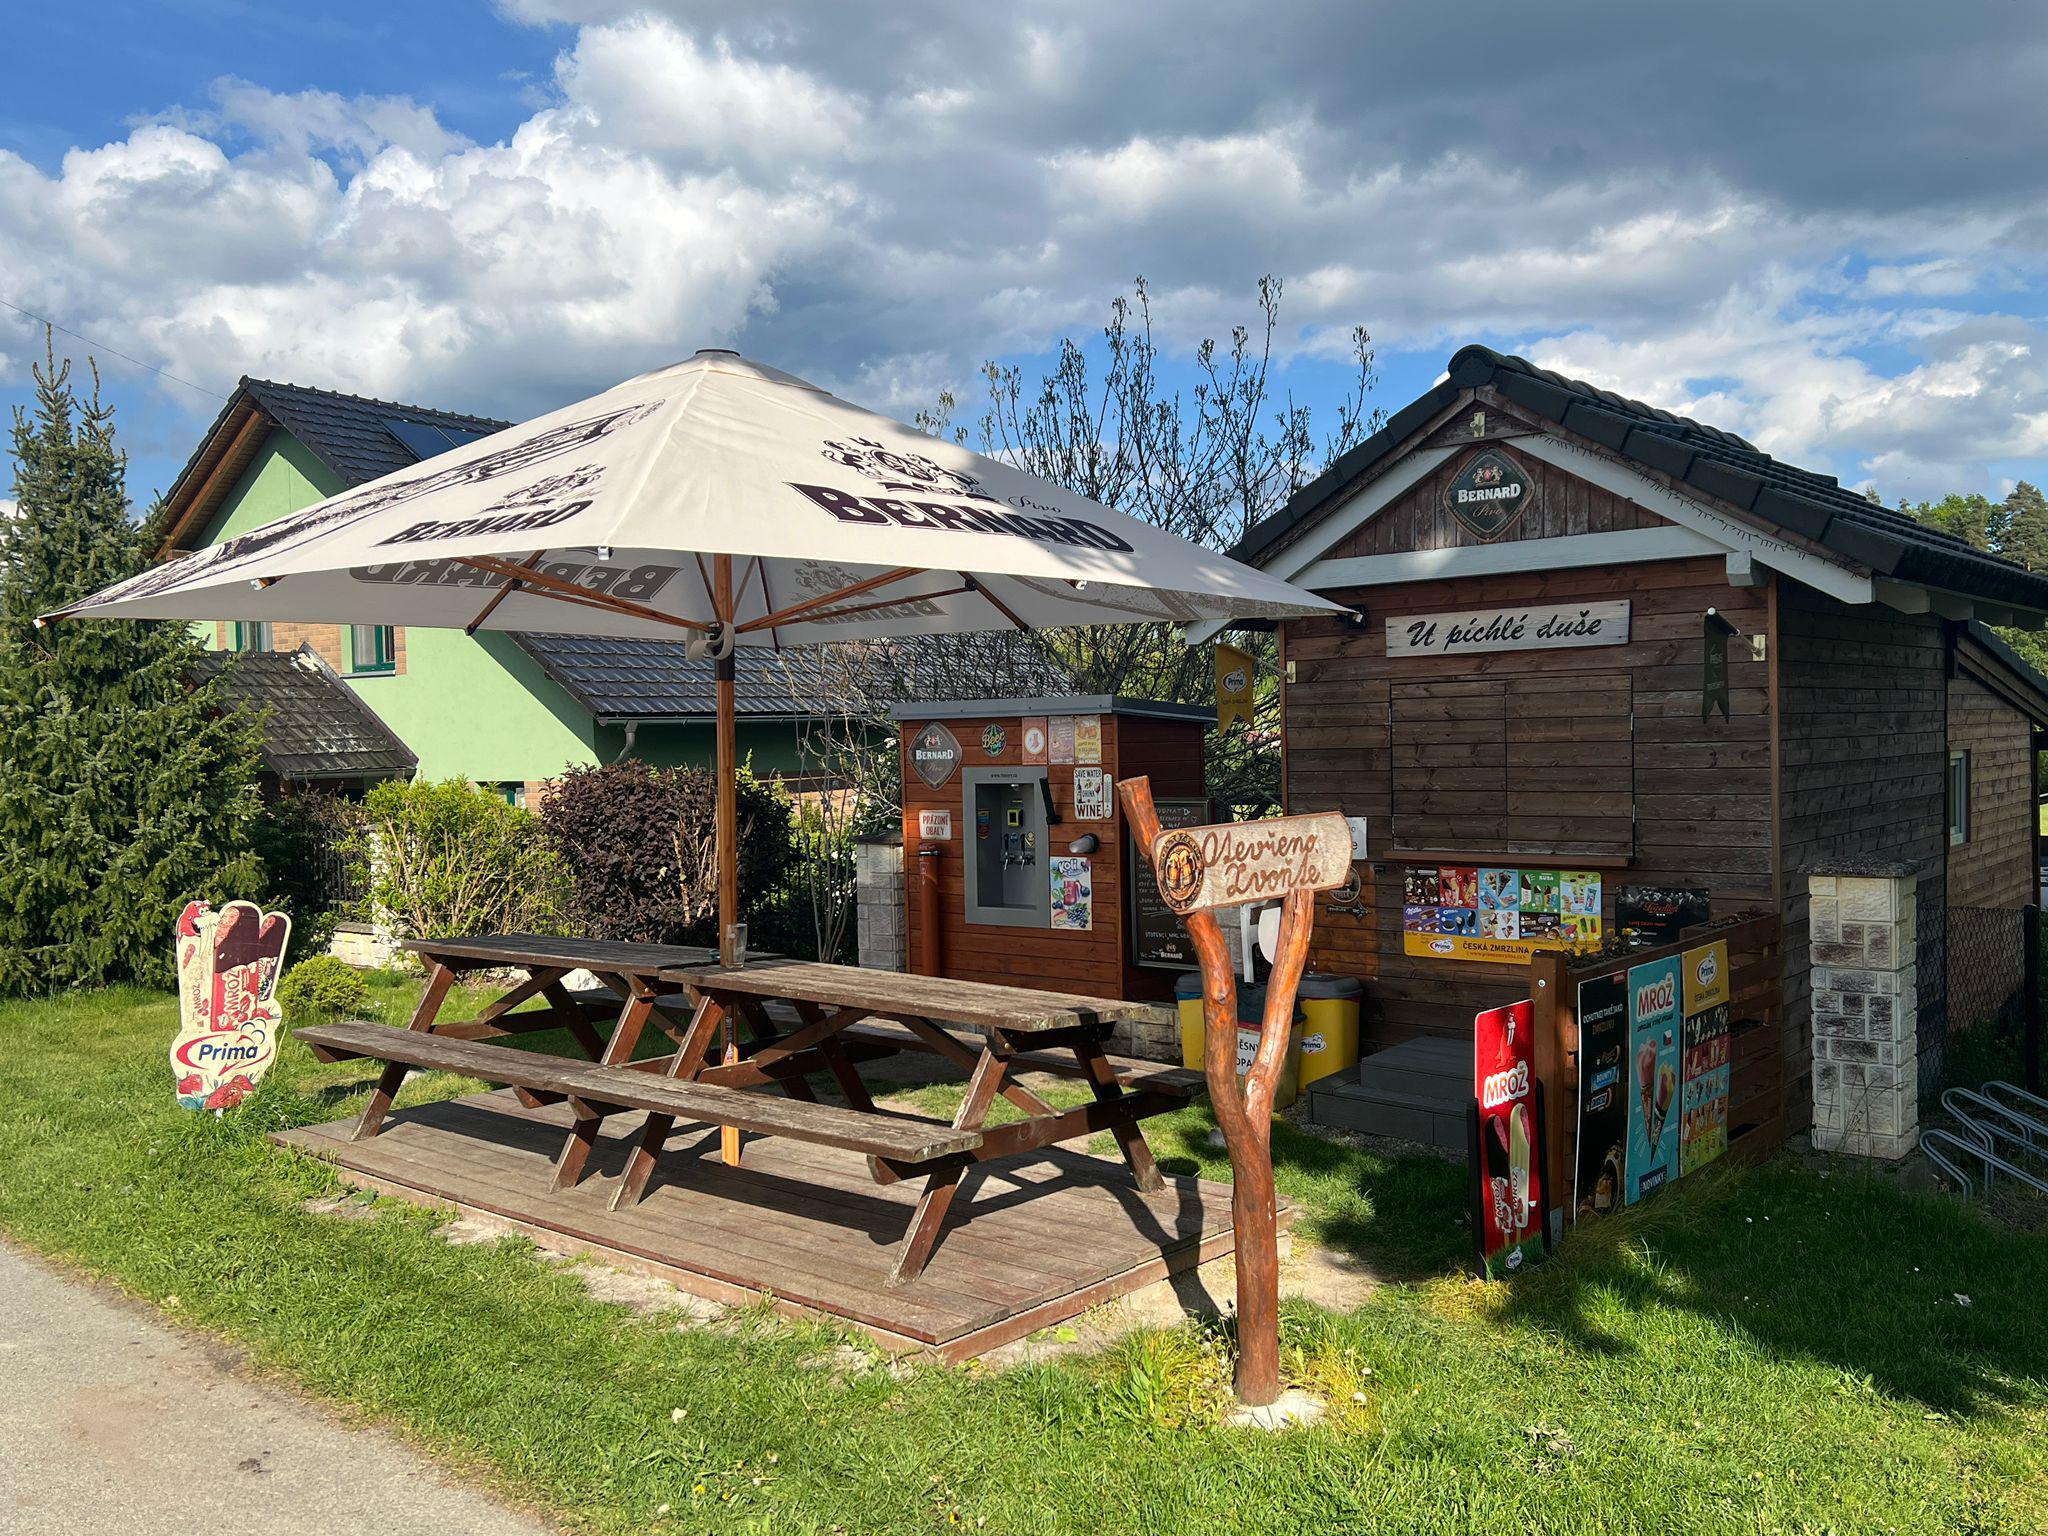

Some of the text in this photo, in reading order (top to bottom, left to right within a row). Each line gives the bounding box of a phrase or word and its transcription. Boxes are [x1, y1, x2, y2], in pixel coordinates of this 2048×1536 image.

[1458, 483, 1521, 503] BERNARD
[1008, 495, 1062, 513] Pivo
[369, 500, 593, 547] BERNARD
[783, 481, 1134, 553] BERNARD
[1406, 609, 1602, 651] U píchlé duše
[981, 729, 1005, 749] Beer
[915, 749, 954, 761] BERNARD
[1075, 769, 1101, 778] SAVE WATER
[1077, 804, 1102, 817] WINE
[925, 825, 945, 836] OBALY
[1058, 858, 1079, 875] Koli
[1434, 942, 1450, 951] Prima
[1462, 940, 1529, 954] ČESKÁ ZMRZLINA
[1701, 966, 1714, 977] Prima
[1638, 976, 1674, 1017] MROŽ
[198, 1042, 258, 1061] Prima
[1301, 1037, 1321, 1049] Prima
[1486, 1065, 1527, 1100] MROŽ
